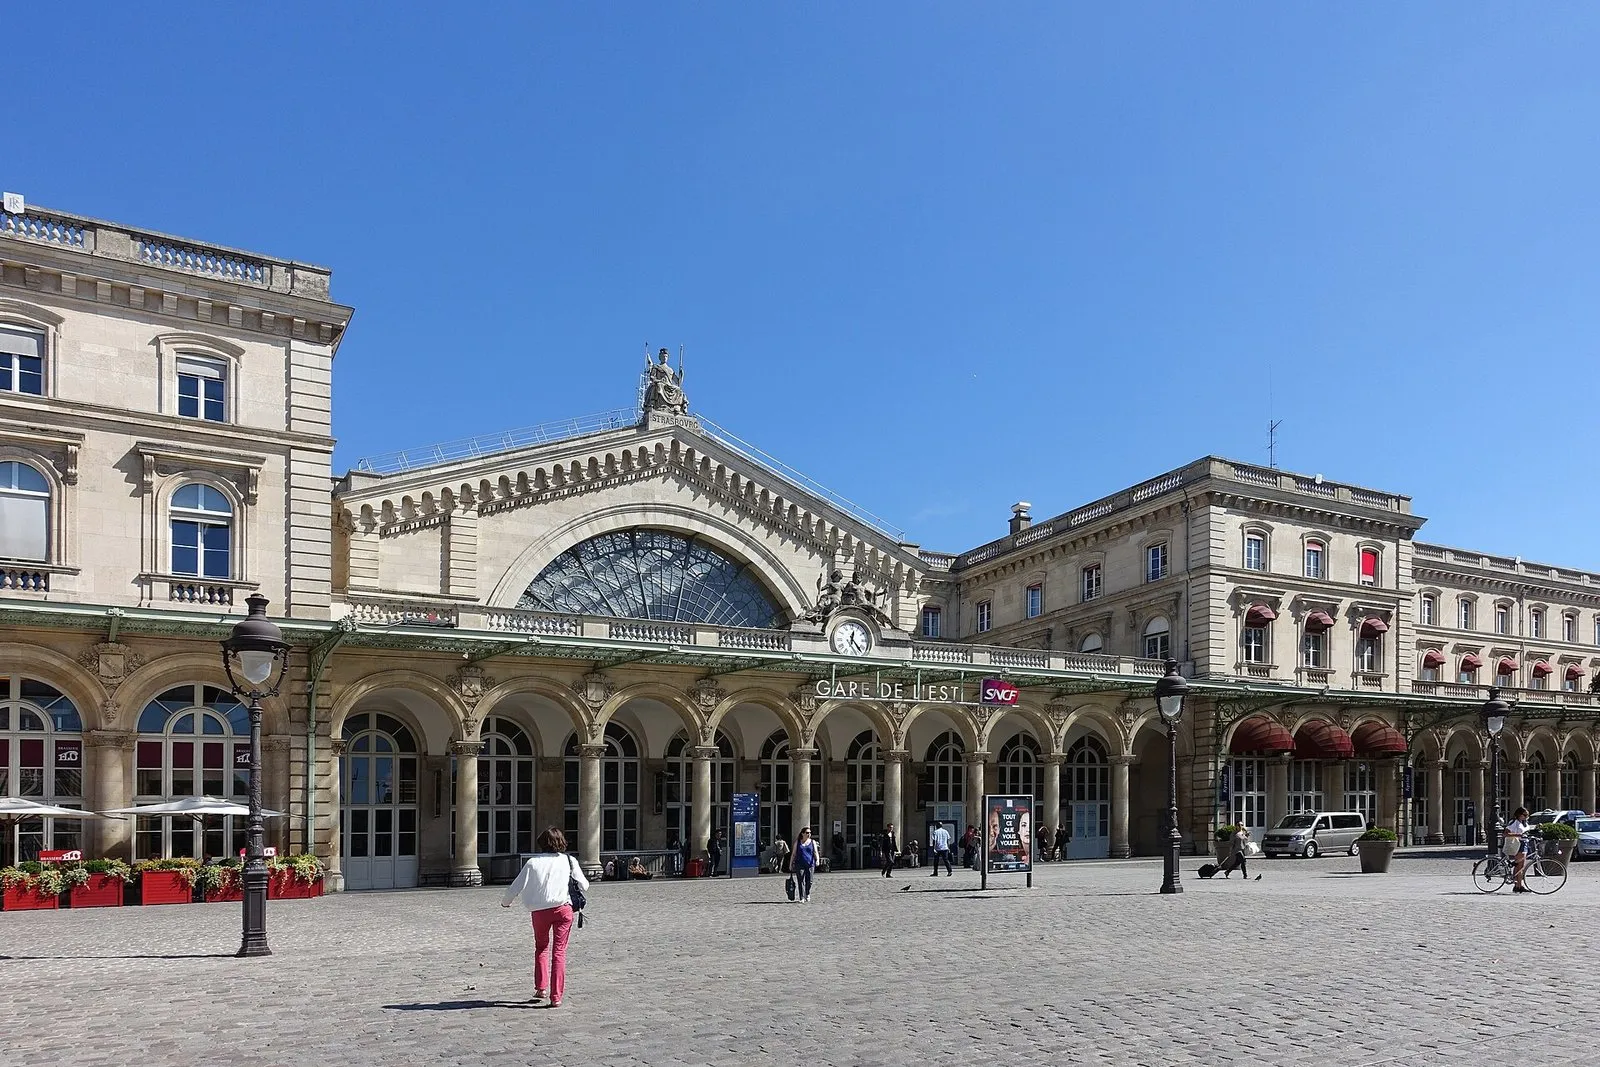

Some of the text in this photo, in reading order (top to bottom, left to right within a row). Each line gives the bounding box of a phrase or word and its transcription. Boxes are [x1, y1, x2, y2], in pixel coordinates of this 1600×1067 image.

[816, 680, 870, 698] GARE
[880, 682, 903, 699] DE
[984, 688, 1018, 701] SNCF
